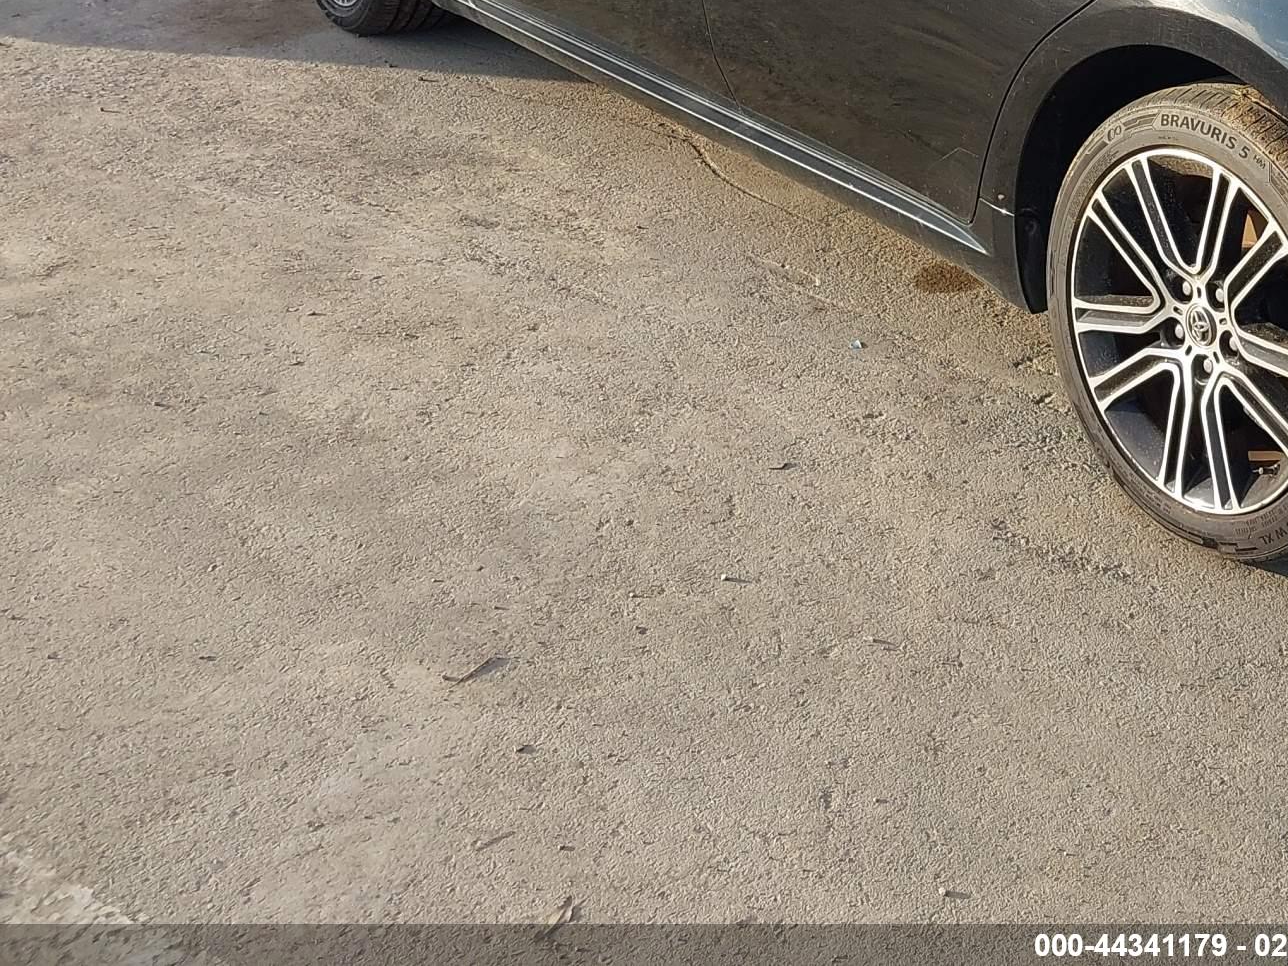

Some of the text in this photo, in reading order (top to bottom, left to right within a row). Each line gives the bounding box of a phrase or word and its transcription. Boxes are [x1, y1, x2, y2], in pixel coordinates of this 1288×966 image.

[1160, 113, 1237, 150] BRAVURIS
[1238, 145, 1251, 160] 5
[1259, 534, 1275, 545] XL
[1275, 526, 1288, 540] W
